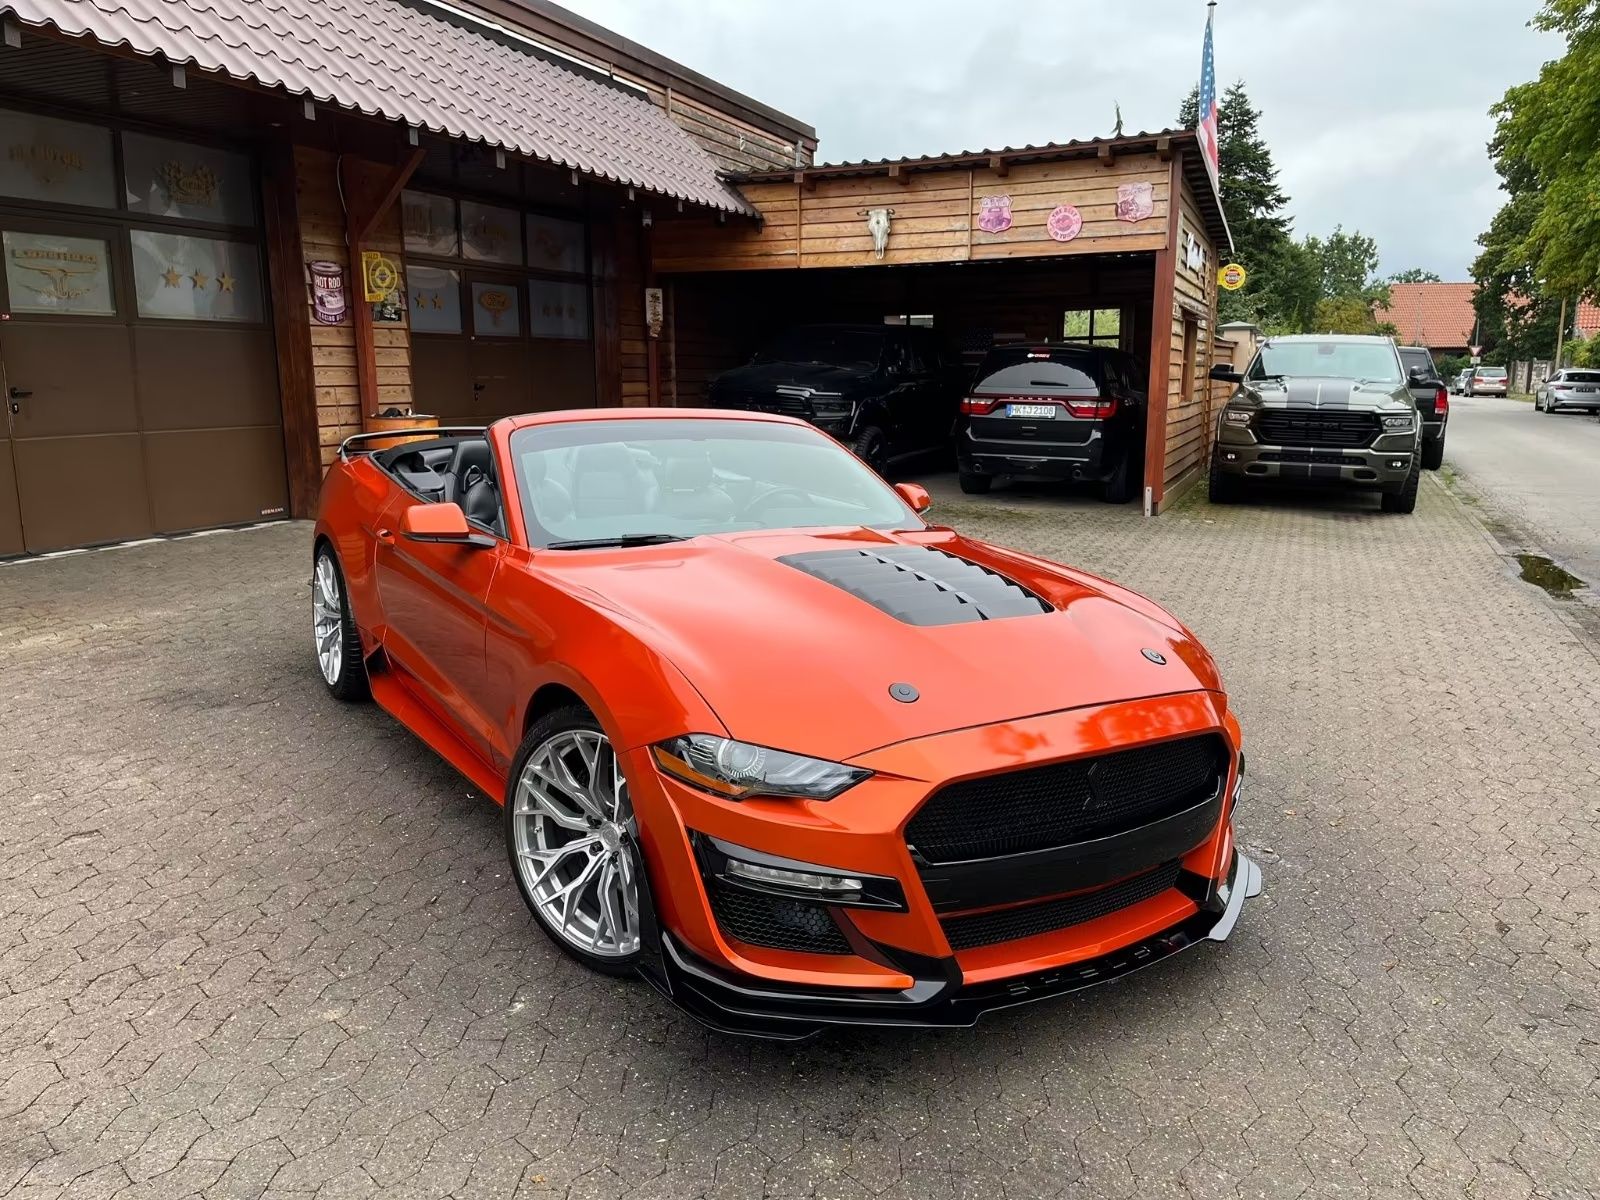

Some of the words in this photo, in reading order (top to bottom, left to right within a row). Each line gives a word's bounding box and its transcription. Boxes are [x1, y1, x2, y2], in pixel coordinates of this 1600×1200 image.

[1052, 208, 1062, 217] THE
[314, 275, 328, 288] HOT
[328, 276, 341, 289] ROD
[1011, 406, 1021, 414] HK
[1033, 406, 1054, 415] 2108
